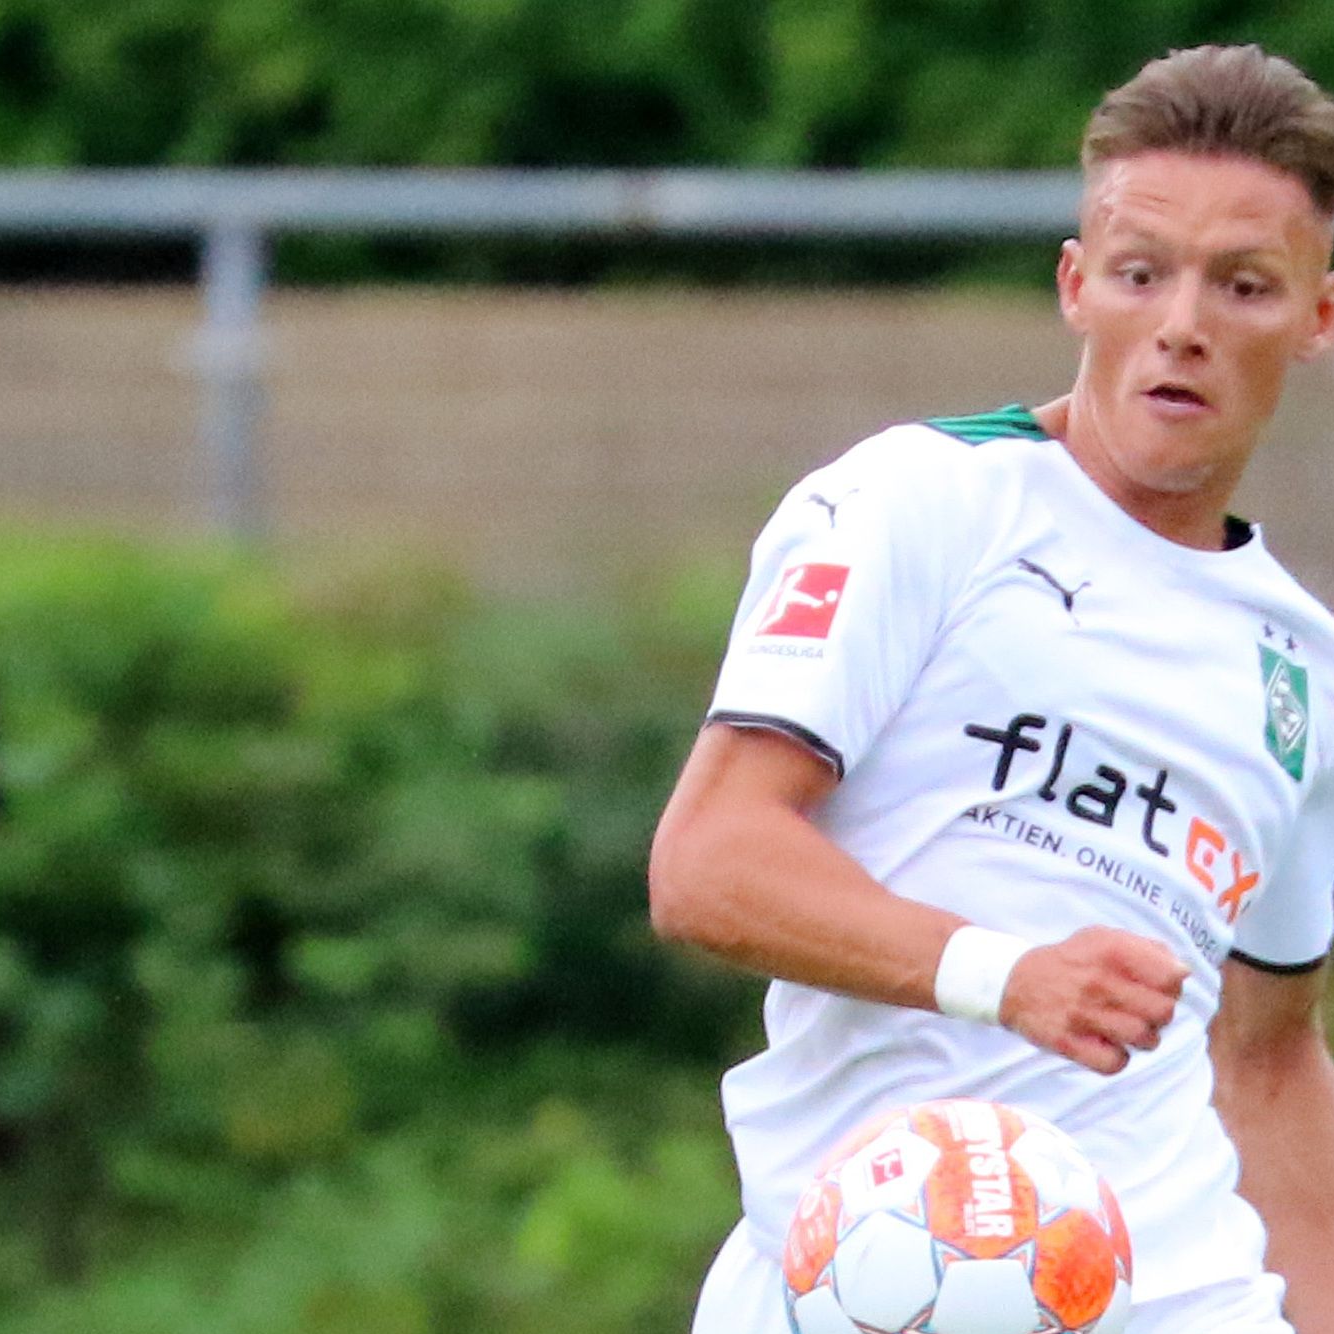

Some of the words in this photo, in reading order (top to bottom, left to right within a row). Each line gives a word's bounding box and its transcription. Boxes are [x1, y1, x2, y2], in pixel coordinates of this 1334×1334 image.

[961, 805, 1066, 858] AKTIEN.
[1076, 846, 1164, 909] ONLINE.
[963, 712, 1261, 924] flatex
